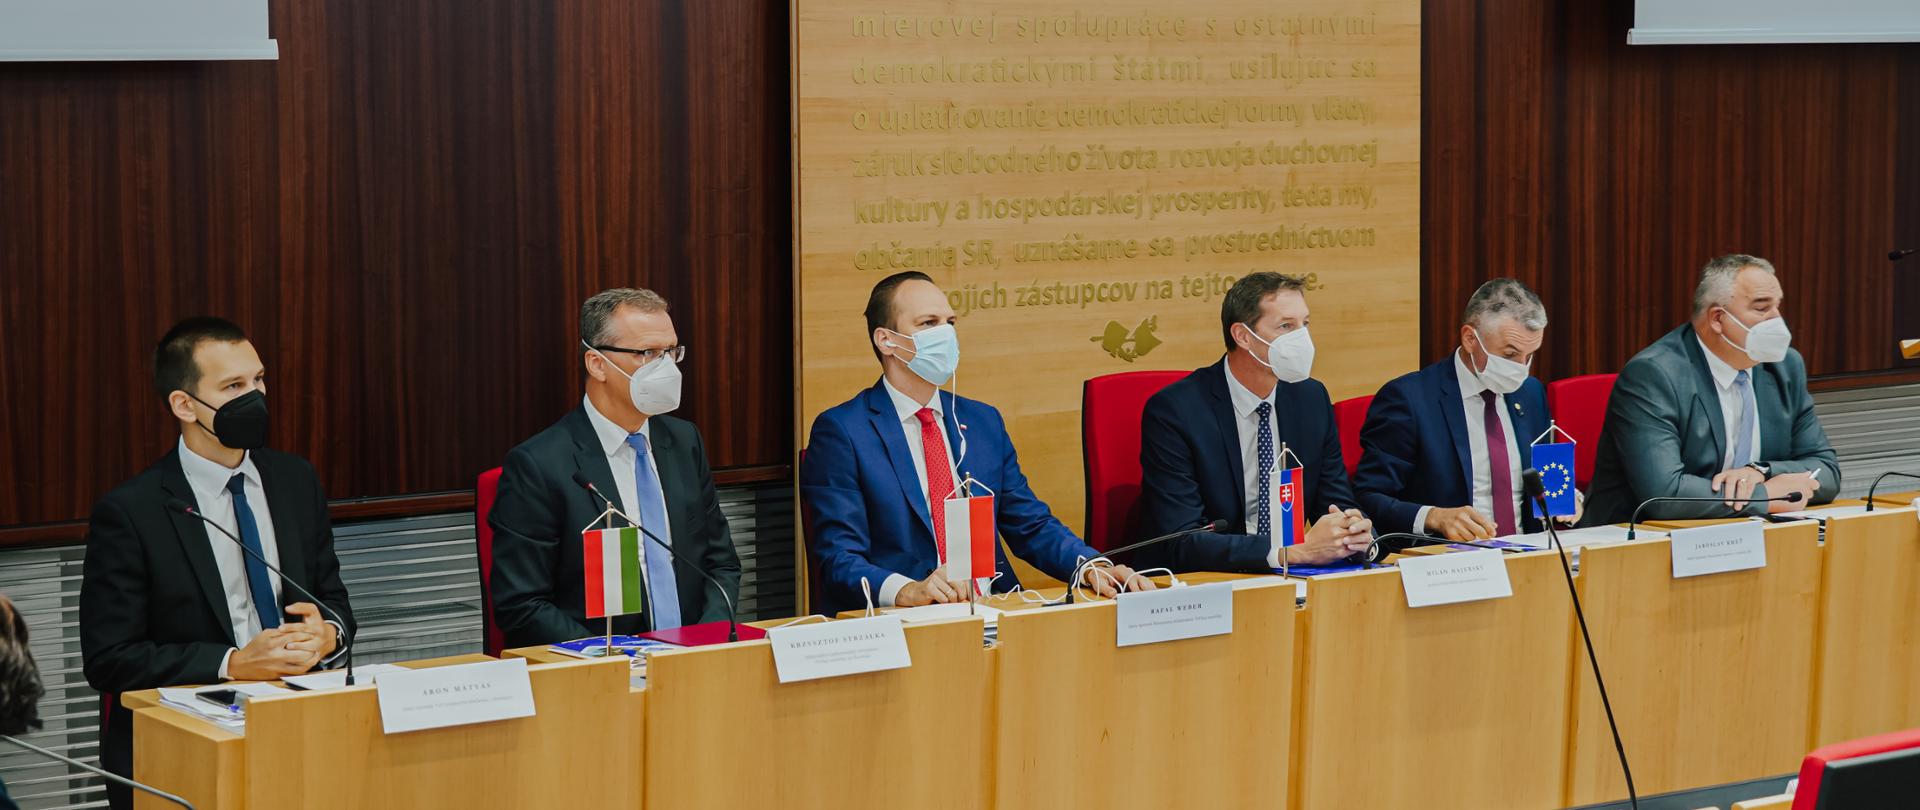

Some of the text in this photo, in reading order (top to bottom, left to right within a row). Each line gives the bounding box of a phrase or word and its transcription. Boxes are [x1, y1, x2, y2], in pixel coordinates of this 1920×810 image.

[852, 10, 998, 44] mierovej
[1015, 9, 1186, 44] spolupráce
[1205, 16, 1217, 37] s
[852, 55, 1097, 89] demokratickými
[1350, 58, 1377, 79] sa
[852, 109, 869, 131] o
[878, 101, 1050, 136] uplatňovanie
[1056, 99, 1229, 129] demokratickej
[1231, 98, 1304, 128] formy
[852, 149, 926, 178] záruk
[930, 144, 1083, 175] slobodného
[1169, 141, 1256, 172] rozvoja
[1259, 138, 1379, 169] duchovnej
[853, 195, 950, 228] kultury
[954, 201, 972, 221] a
[977, 188, 1144, 223] hospodárskej
[1150, 186, 1276, 221] prosperity,
[1282, 180, 1332, 208] teda
[853, 223, 1377, 271] občania SR, uznášame sa prostredníctvom
[943, 280, 1008, 318] ojich
[1014, 278, 1138, 310] zástupcov
[1145, 278, 1174, 301] na
[1180, 272, 1236, 303] tejto
